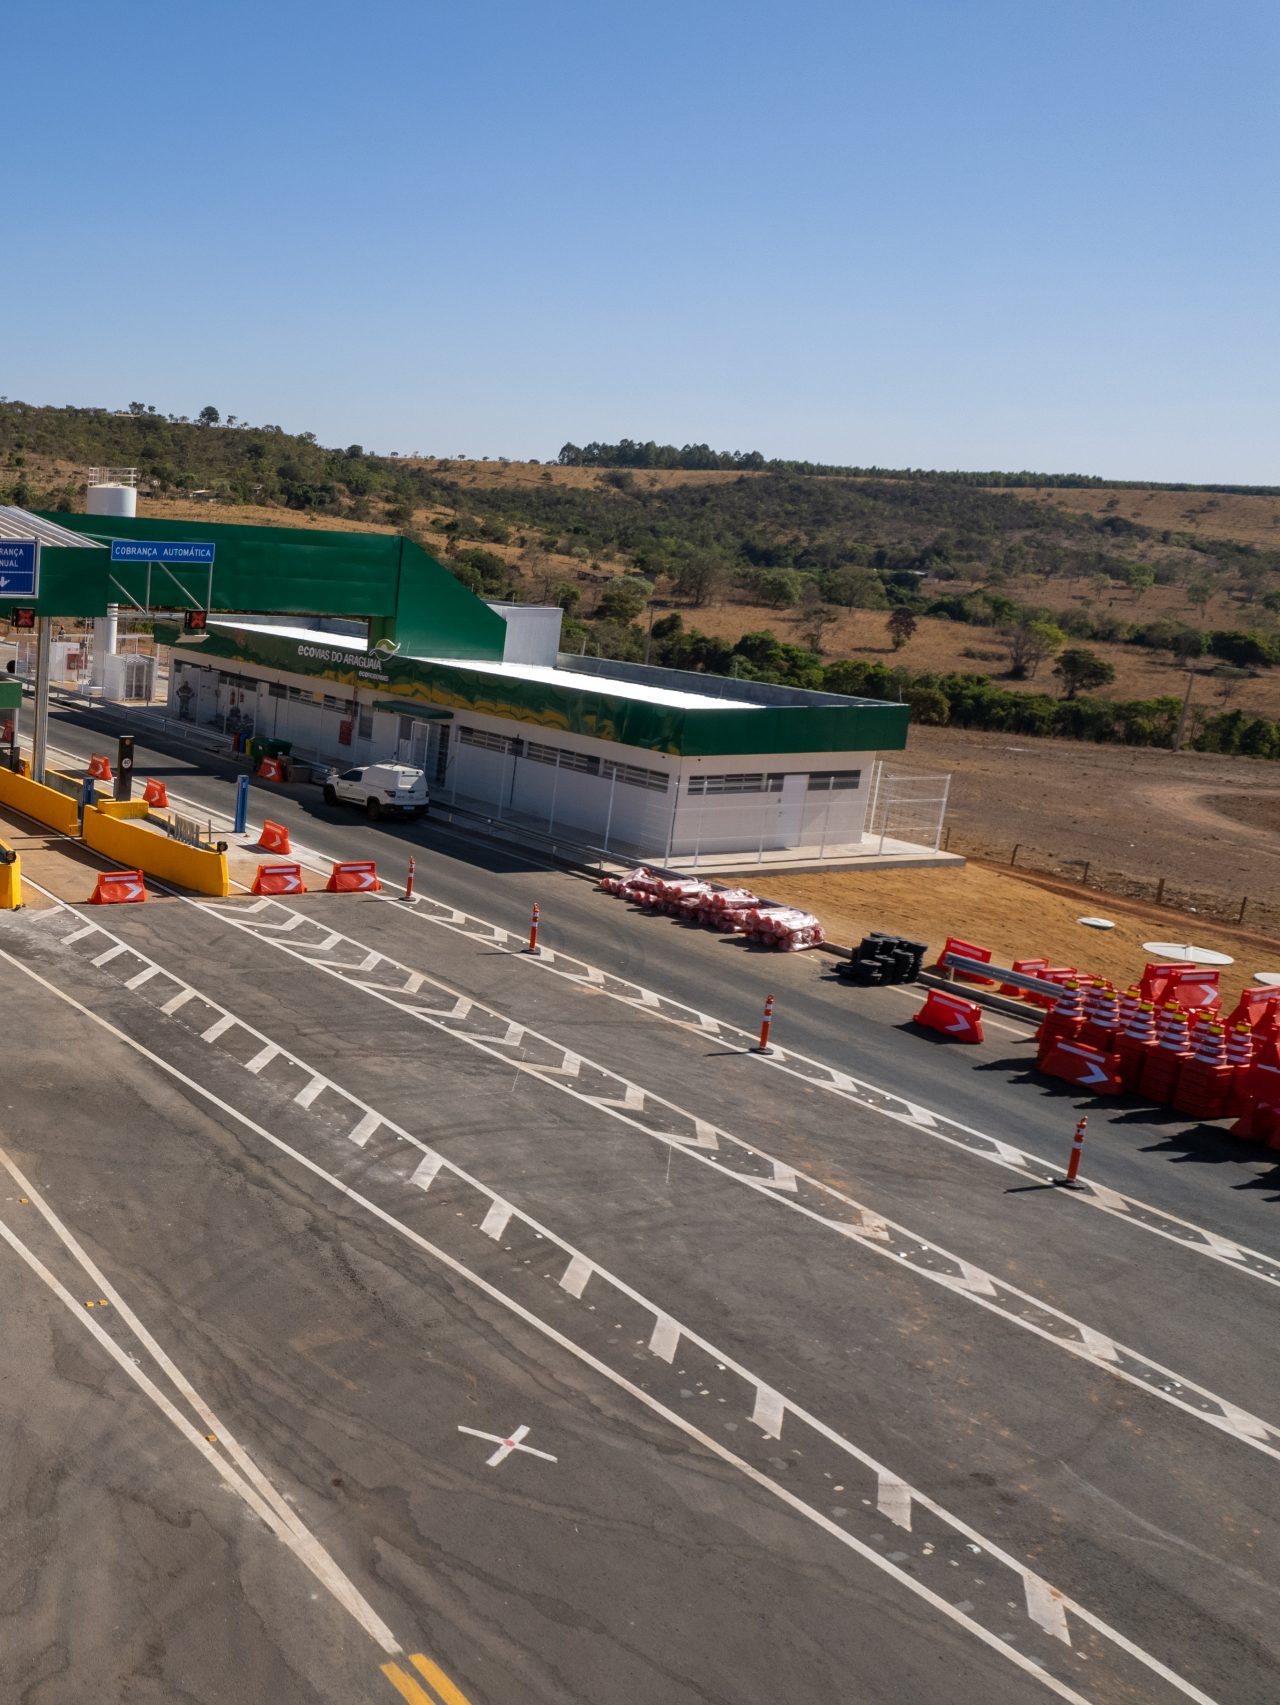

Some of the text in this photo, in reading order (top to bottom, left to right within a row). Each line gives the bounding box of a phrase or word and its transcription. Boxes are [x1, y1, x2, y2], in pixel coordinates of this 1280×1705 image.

[115, 546, 212, 557] COBRANÇA AUTOMÁTICA
[331, 651, 343, 663] DO
[344, 654, 382, 670] ARAGUAIA
